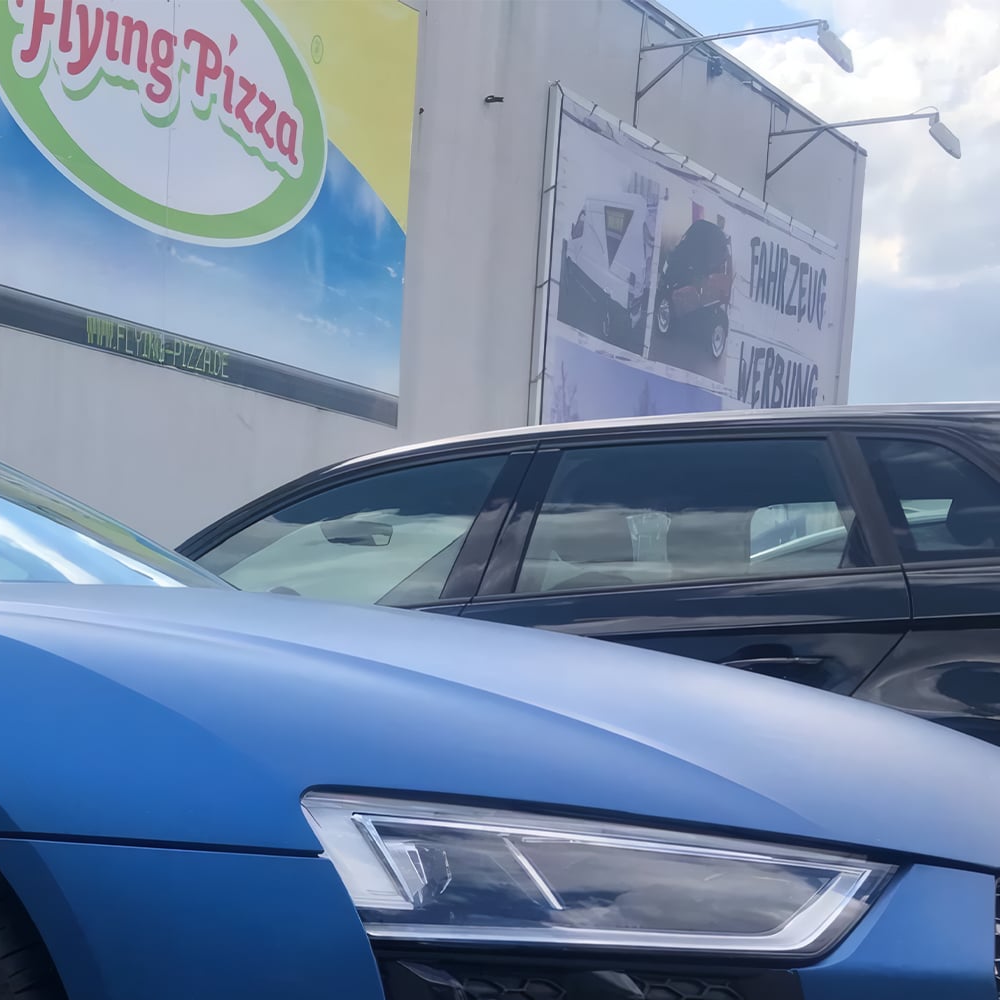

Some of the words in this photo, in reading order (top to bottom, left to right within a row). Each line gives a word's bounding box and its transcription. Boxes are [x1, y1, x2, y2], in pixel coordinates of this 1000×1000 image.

[15, 0, 177, 103] Flying
[750, 236, 827, 331] FAHRZEUG
[737, 341, 819, 409] WERBUNG
